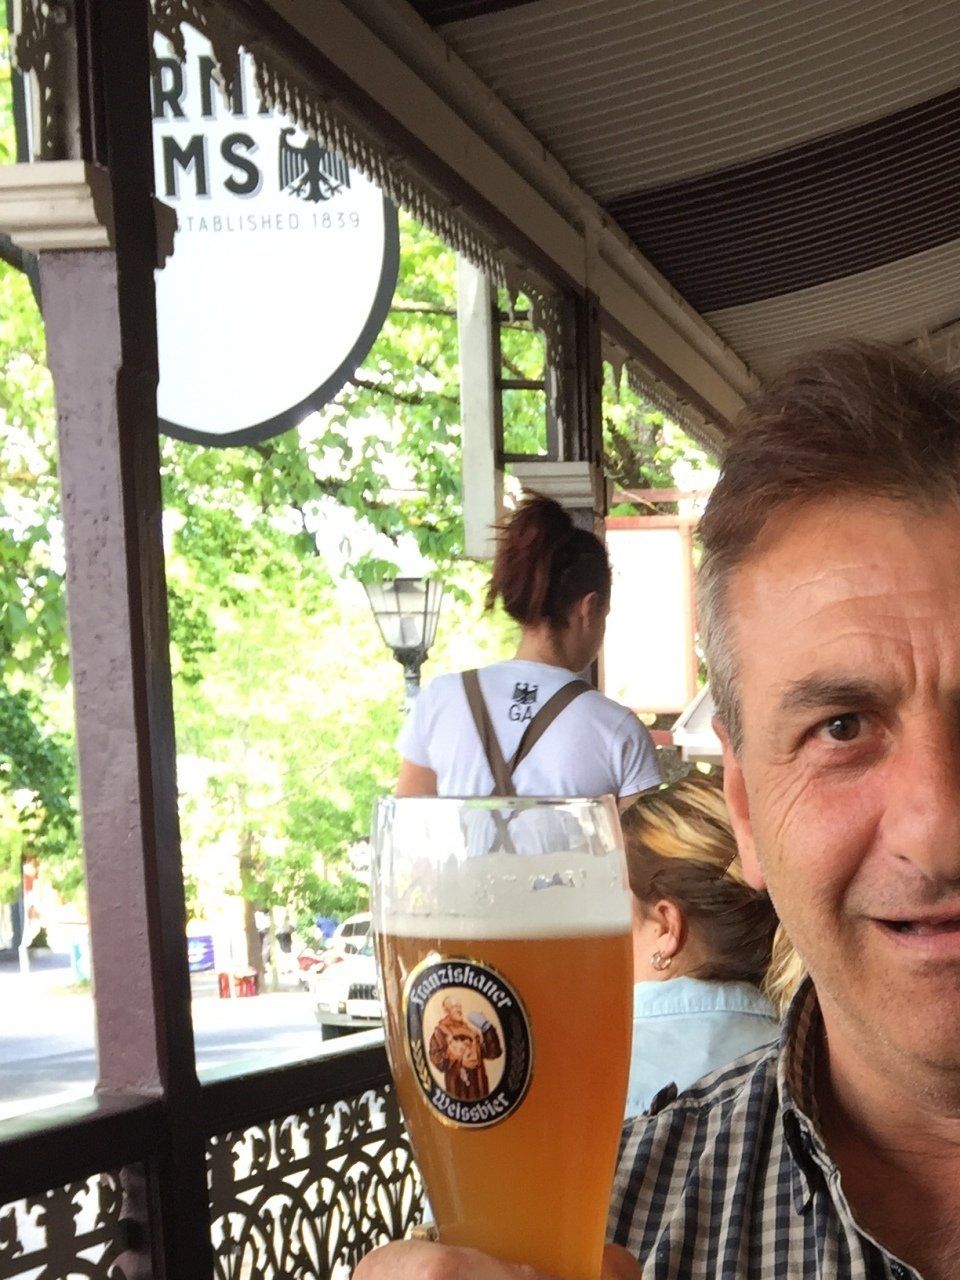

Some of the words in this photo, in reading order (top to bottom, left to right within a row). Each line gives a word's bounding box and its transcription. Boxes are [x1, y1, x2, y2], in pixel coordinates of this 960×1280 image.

[152, 55, 270, 117] RN
[312, 211, 360, 229] 1839
[508, 704, 533, 722] GA
[410, 964, 513, 1010] Franziskaner
[432, 1087, 509, 1122] Weissbier
